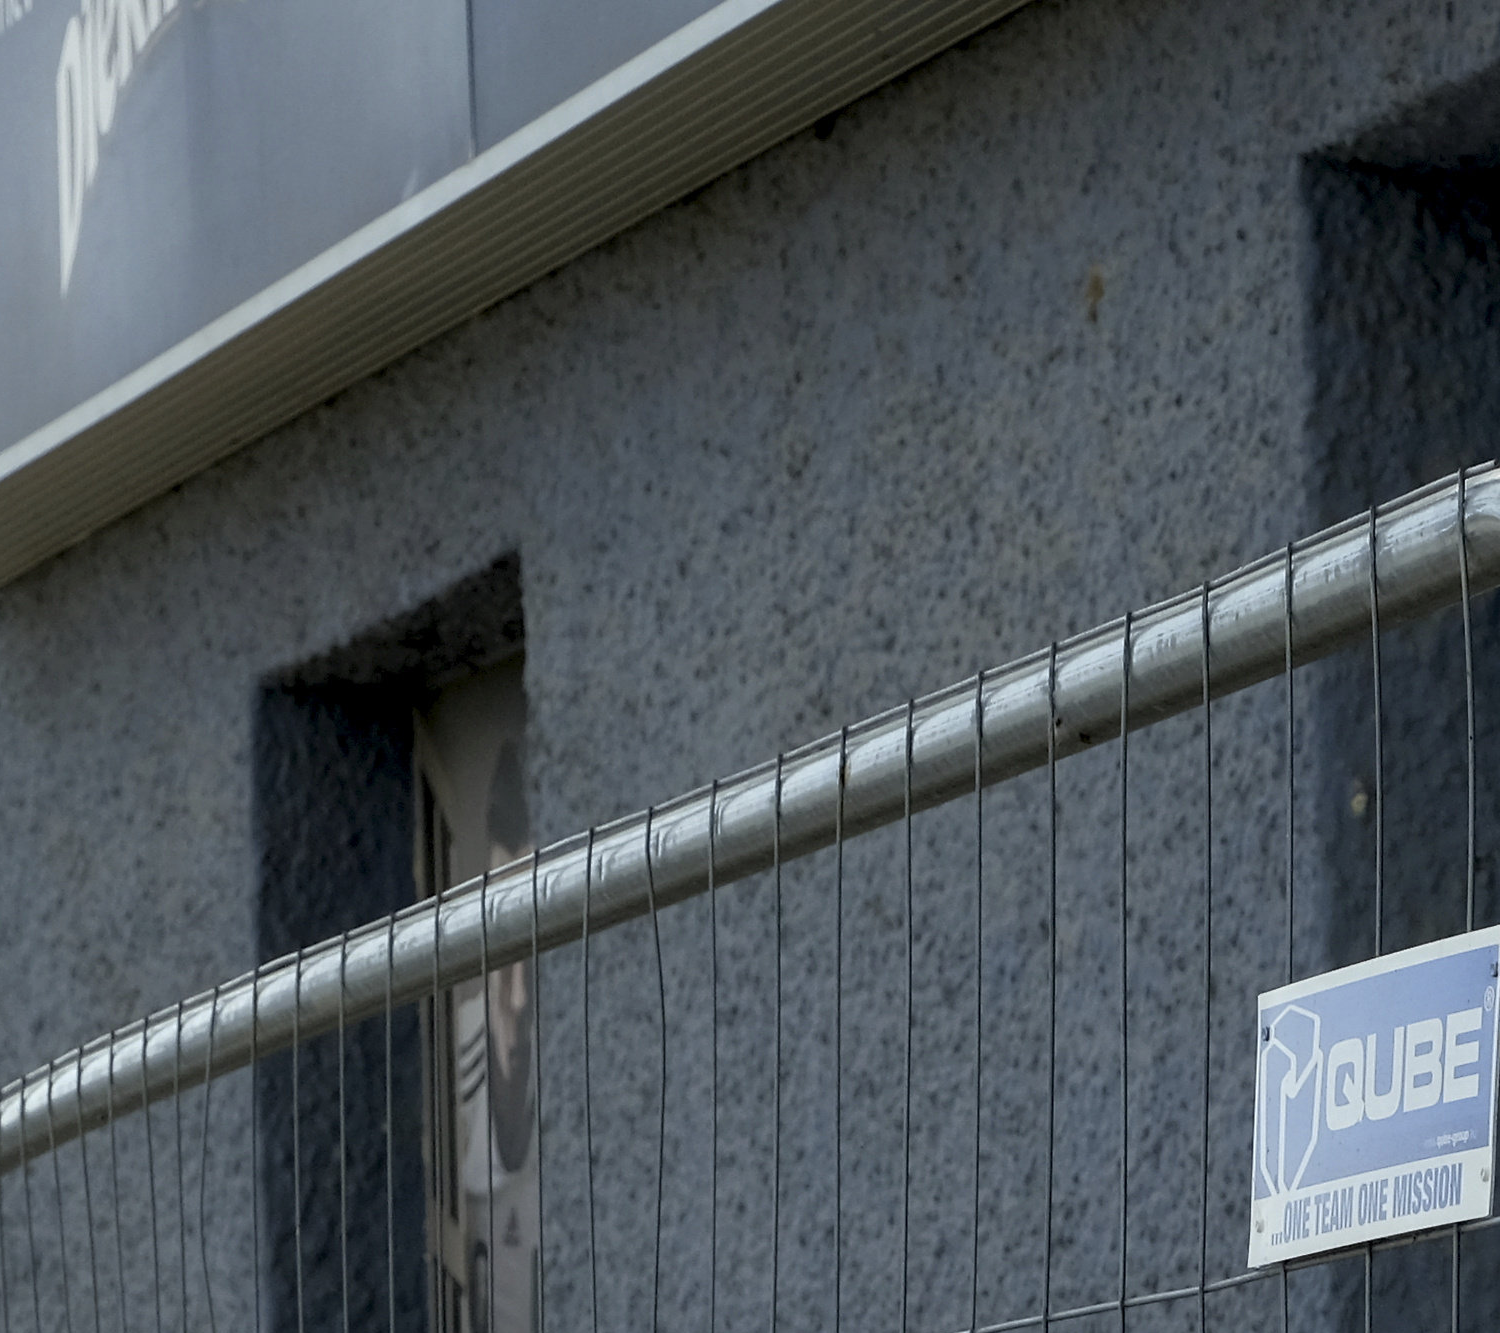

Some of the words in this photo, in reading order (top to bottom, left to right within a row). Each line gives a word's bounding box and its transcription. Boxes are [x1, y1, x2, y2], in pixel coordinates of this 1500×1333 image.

[1326, 1006, 1483, 1131] QUBE
[1315, 1186, 1354, 1236] TEAM
[1358, 1178, 1389, 1226] ONE
[1393, 1163, 1463, 1218] MISSION
